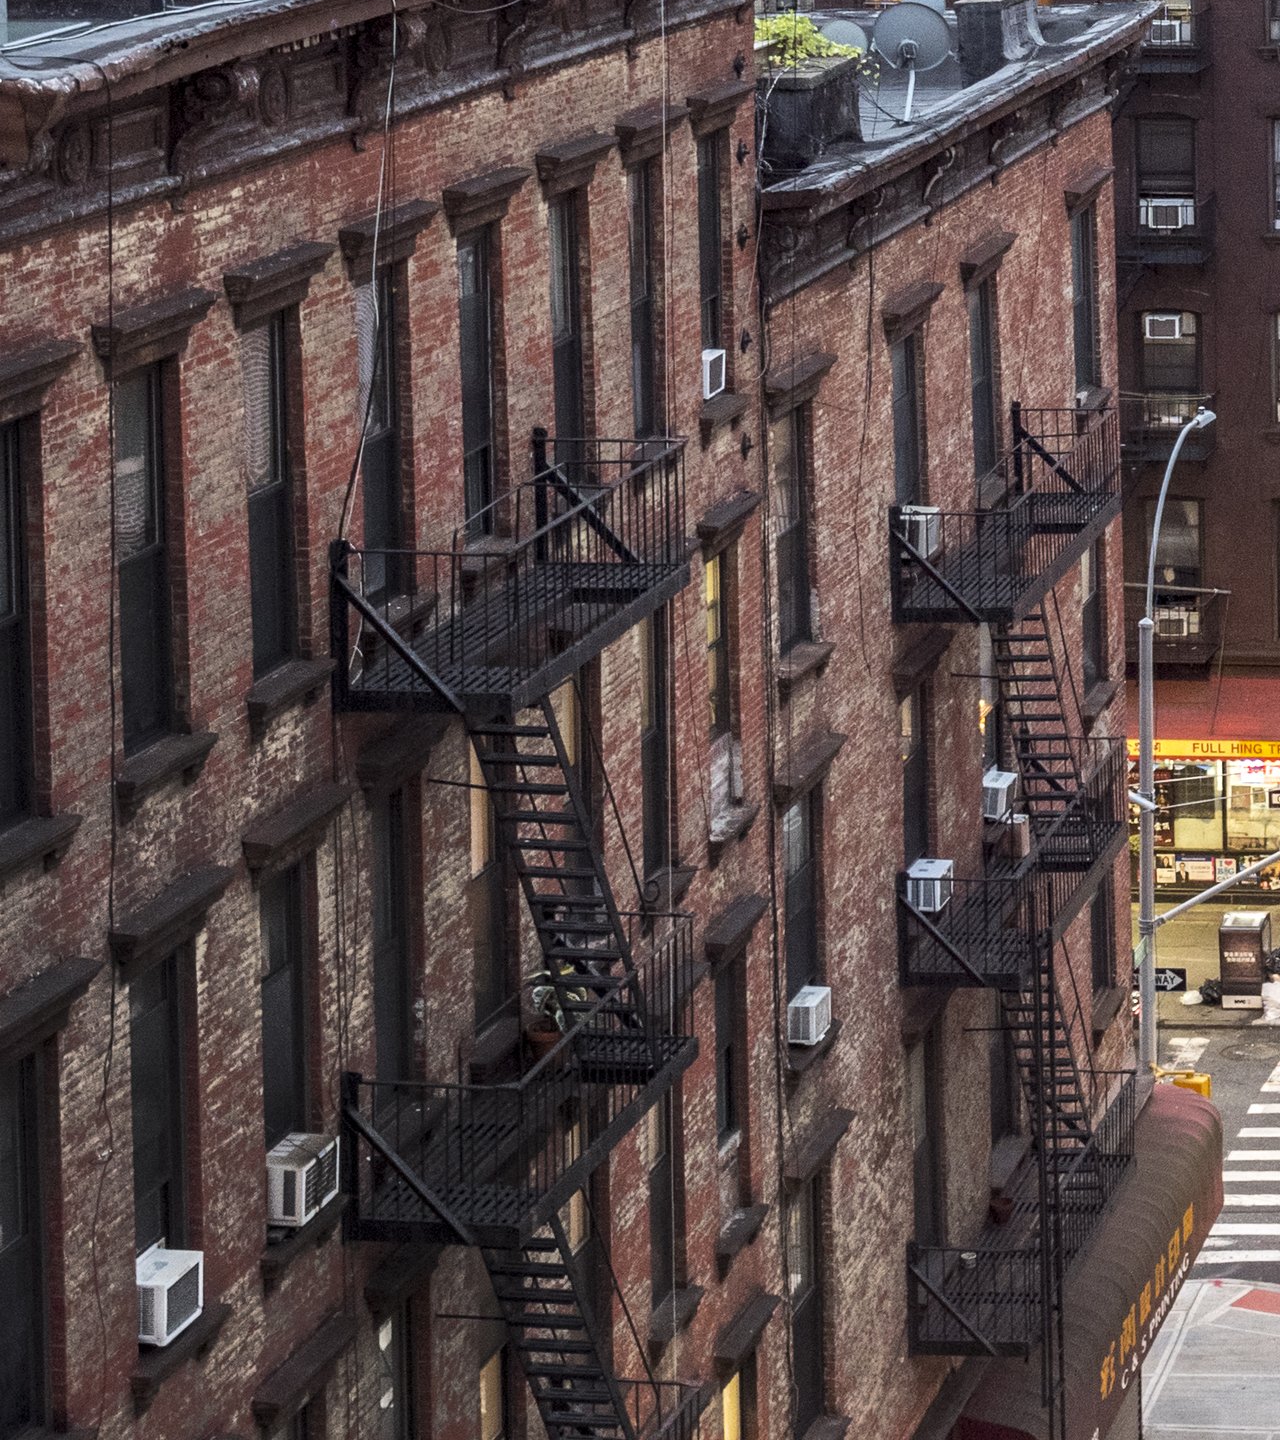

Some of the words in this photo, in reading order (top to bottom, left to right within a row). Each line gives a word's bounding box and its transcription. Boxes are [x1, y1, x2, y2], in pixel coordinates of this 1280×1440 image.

[1193, 742, 1225, 754] FULL
[1231, 743, 1262, 754] HING
[1155, 975, 1176, 985] WAY
[1121, 1368, 1130, 1389] C
[1131, 1351, 1139, 1373] &
[1141, 1333, 1147, 1353] S
[1149, 1252, 1190, 1340] PRINTING
